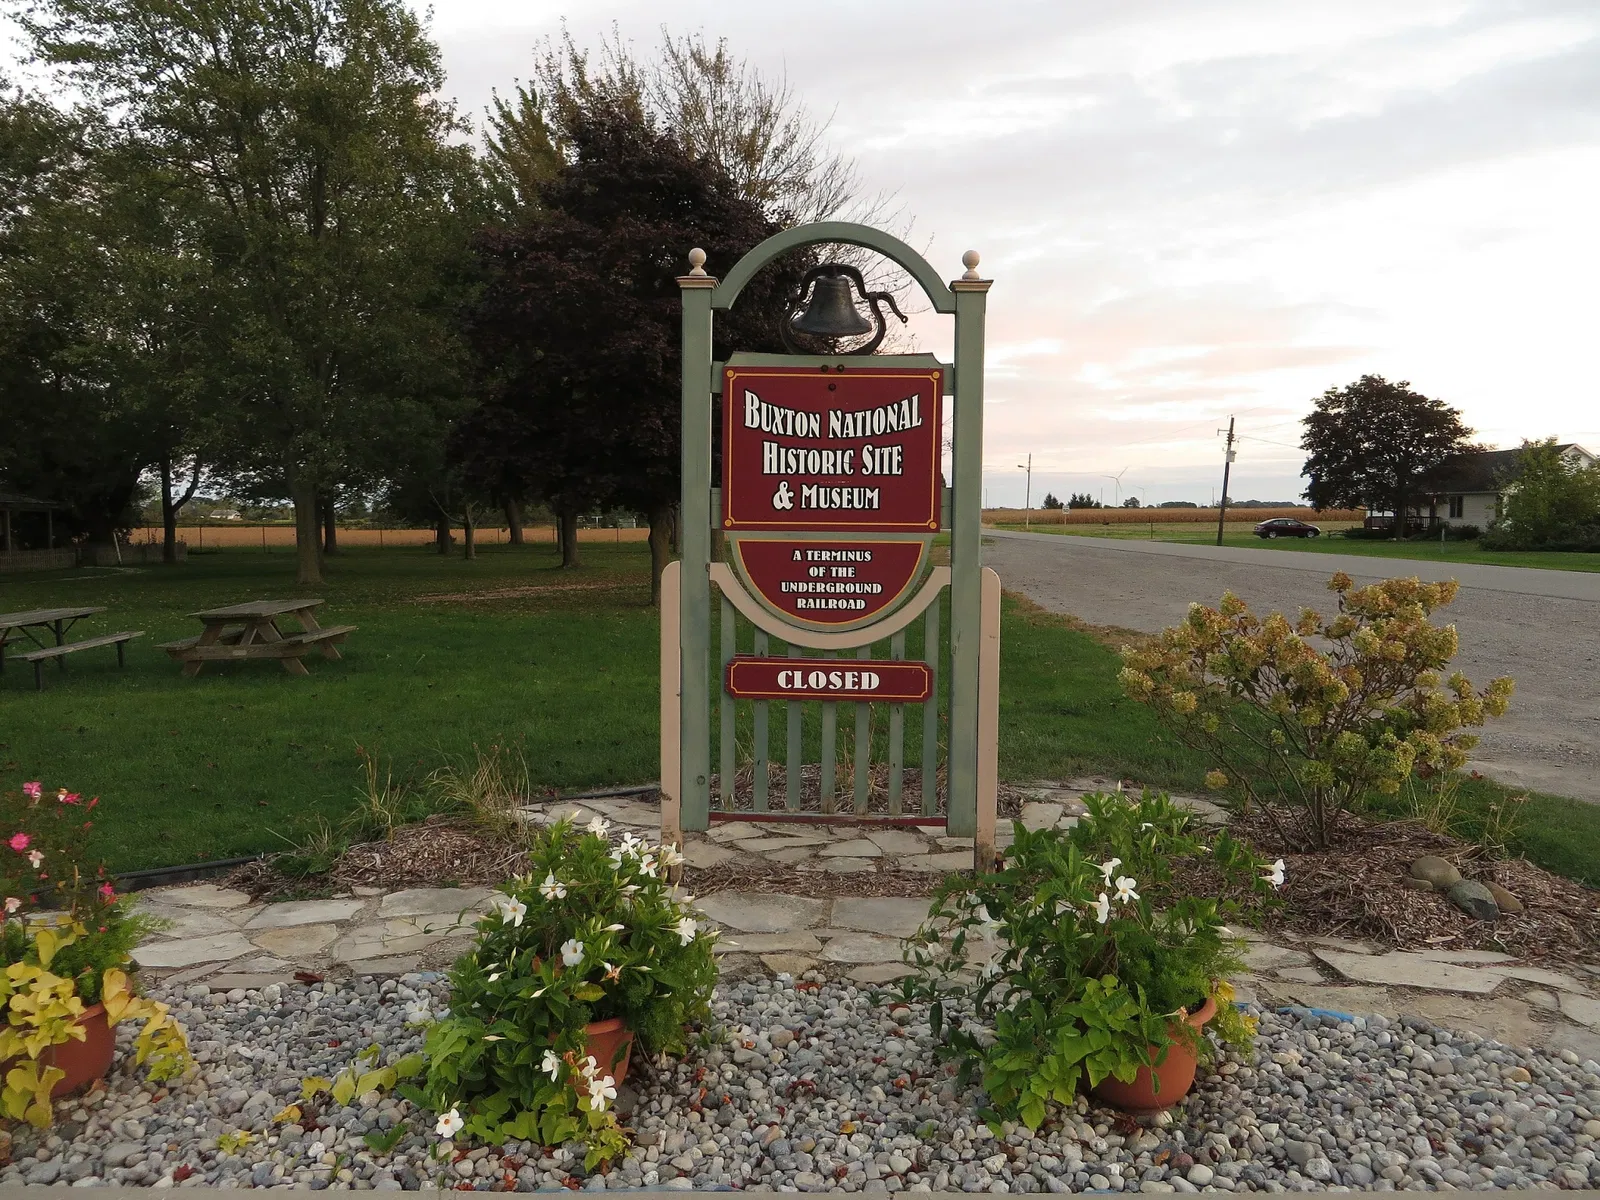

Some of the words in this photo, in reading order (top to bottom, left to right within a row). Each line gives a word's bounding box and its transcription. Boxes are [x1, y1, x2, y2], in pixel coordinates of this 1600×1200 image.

[744, 390, 821, 438] BUXTON
[828, 394, 922, 438] NATIONAL
[763, 441, 854, 475] HISTORIC
[861, 444, 902, 475] SITE
[772, 481, 795, 510] &
[801, 484, 879, 509] MUSEUM
[792, 550, 802, 561] A
[806, 550, 872, 562] TERMINUS
[808, 566, 826, 578] OF
[829, 566, 855, 578] THE
[781, 581, 882, 594] UNDERGROUND
[797, 598, 866, 610] RAILROAD
[777, 670, 880, 690] CLOSED
